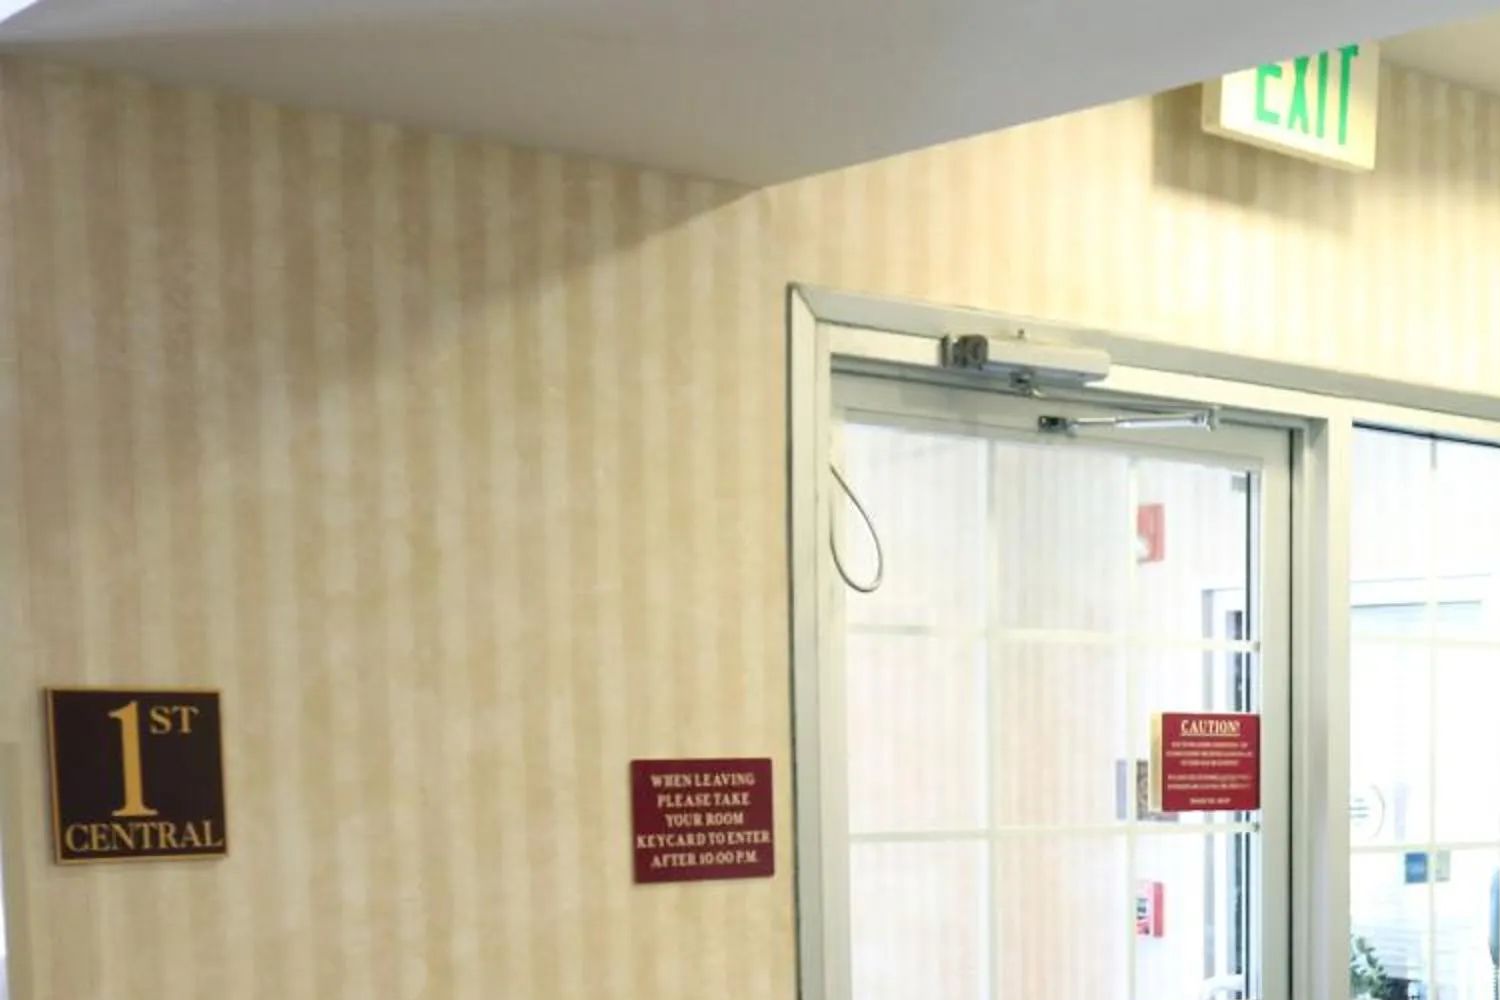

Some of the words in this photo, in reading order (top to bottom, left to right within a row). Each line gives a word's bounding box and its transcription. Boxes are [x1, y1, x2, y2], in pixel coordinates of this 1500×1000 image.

[1254, 43, 1359, 146] EXIT
[651, 773, 692, 788] WHEN
[695, 771, 756, 787] LEAVING
[657, 792, 711, 809] PLEASE
[714, 791, 751, 806] TAKE
[665, 812, 704, 828] YOUR
[706, 811, 744, 827] ROOM
[65, 819, 224, 853] CENTRAL
[637, 832, 706, 849] KEYCARD
[708, 831, 725, 846] TO
[727, 829, 771, 845] ENTER
[651, 852, 697, 869] AFTER
